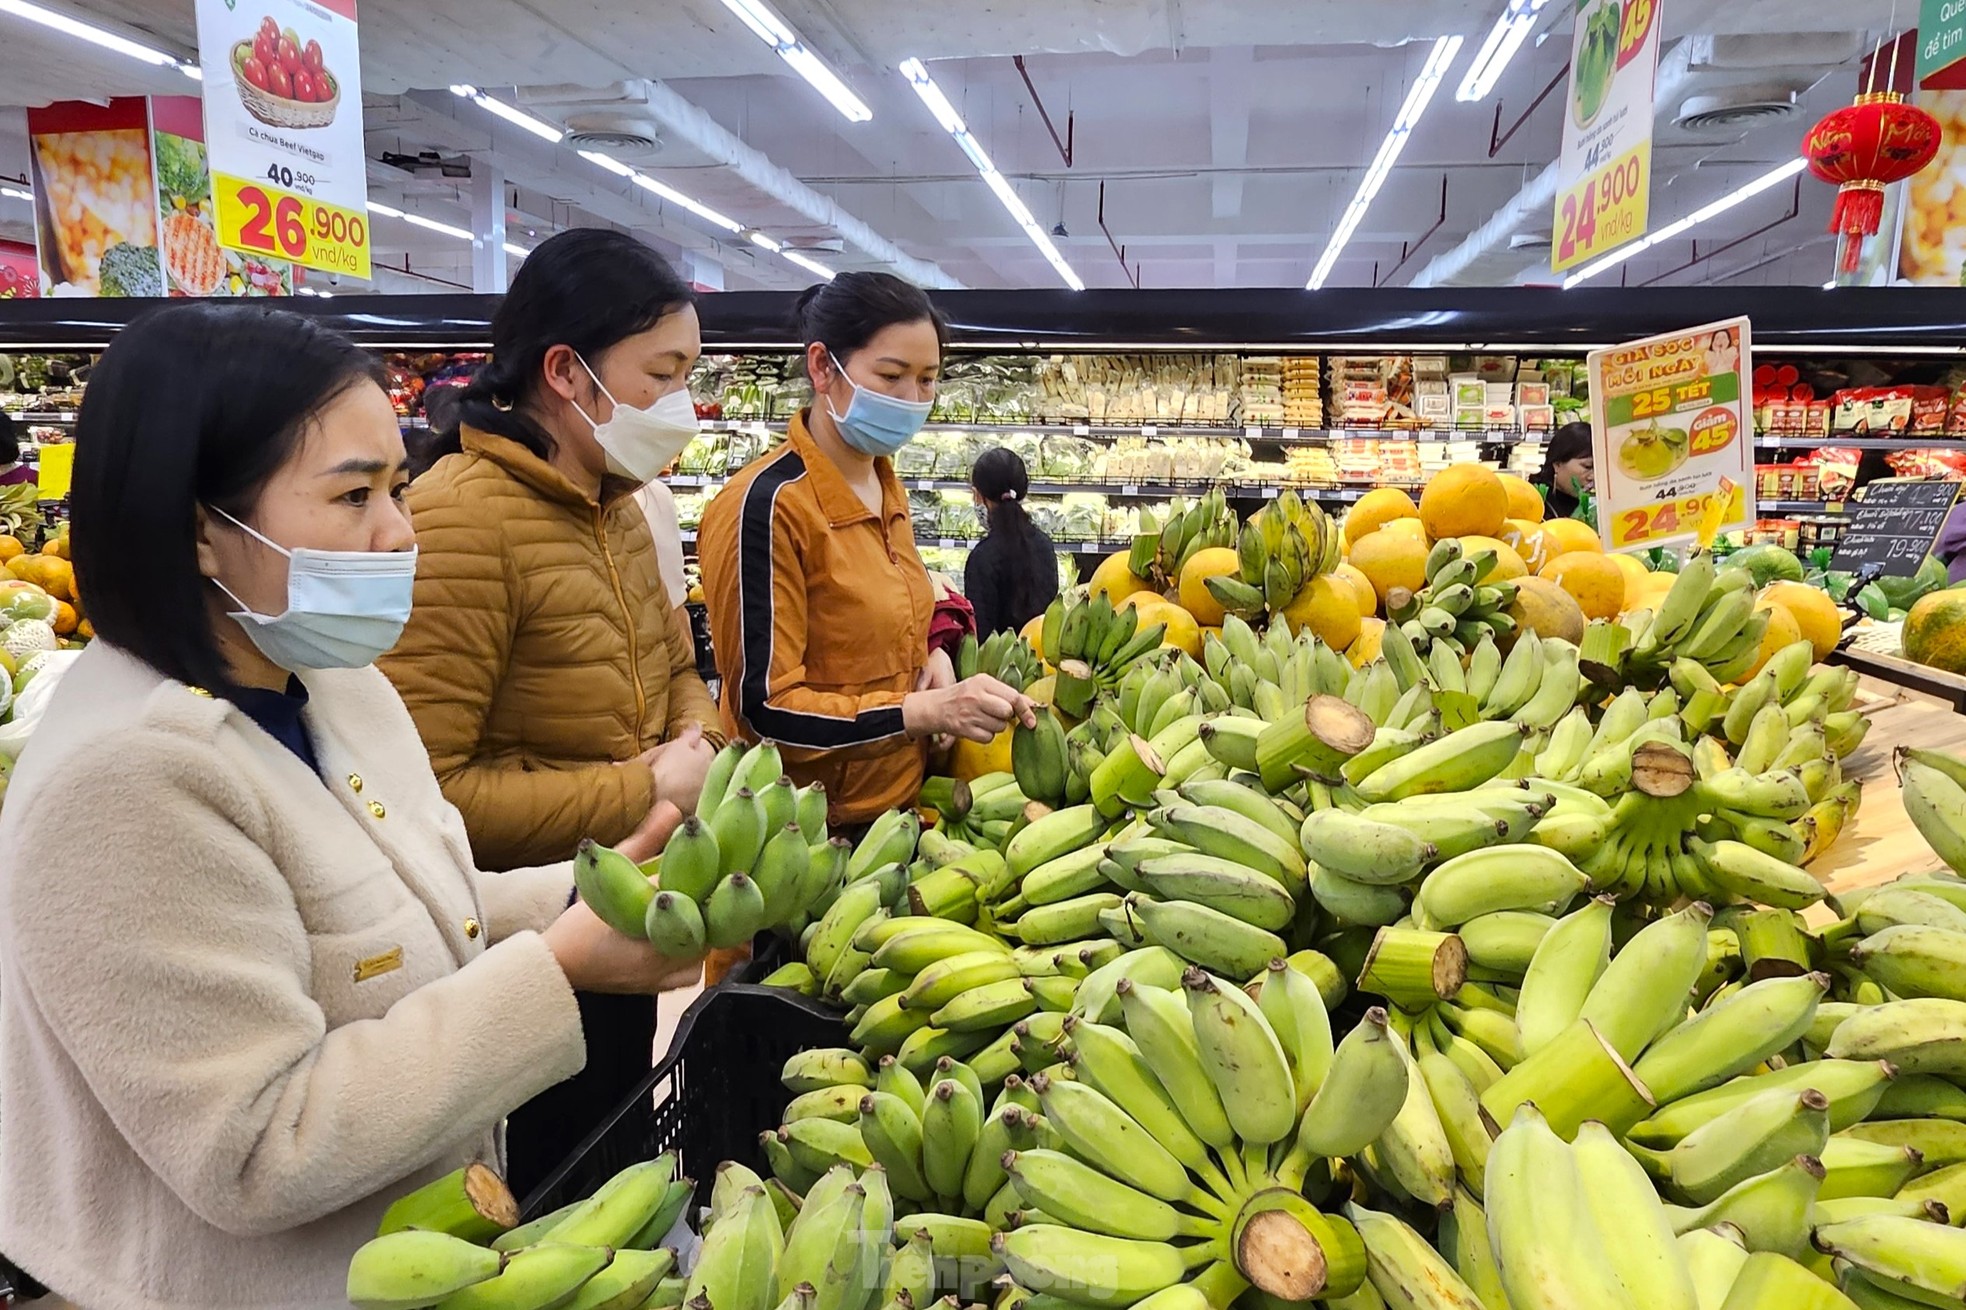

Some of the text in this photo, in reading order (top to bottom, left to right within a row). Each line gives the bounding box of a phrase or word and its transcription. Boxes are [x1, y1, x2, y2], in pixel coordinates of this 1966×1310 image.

[260, 131, 279, 145] chua
[279, 137, 297, 152] Beef
[1632, 386, 1672, 418] 25
